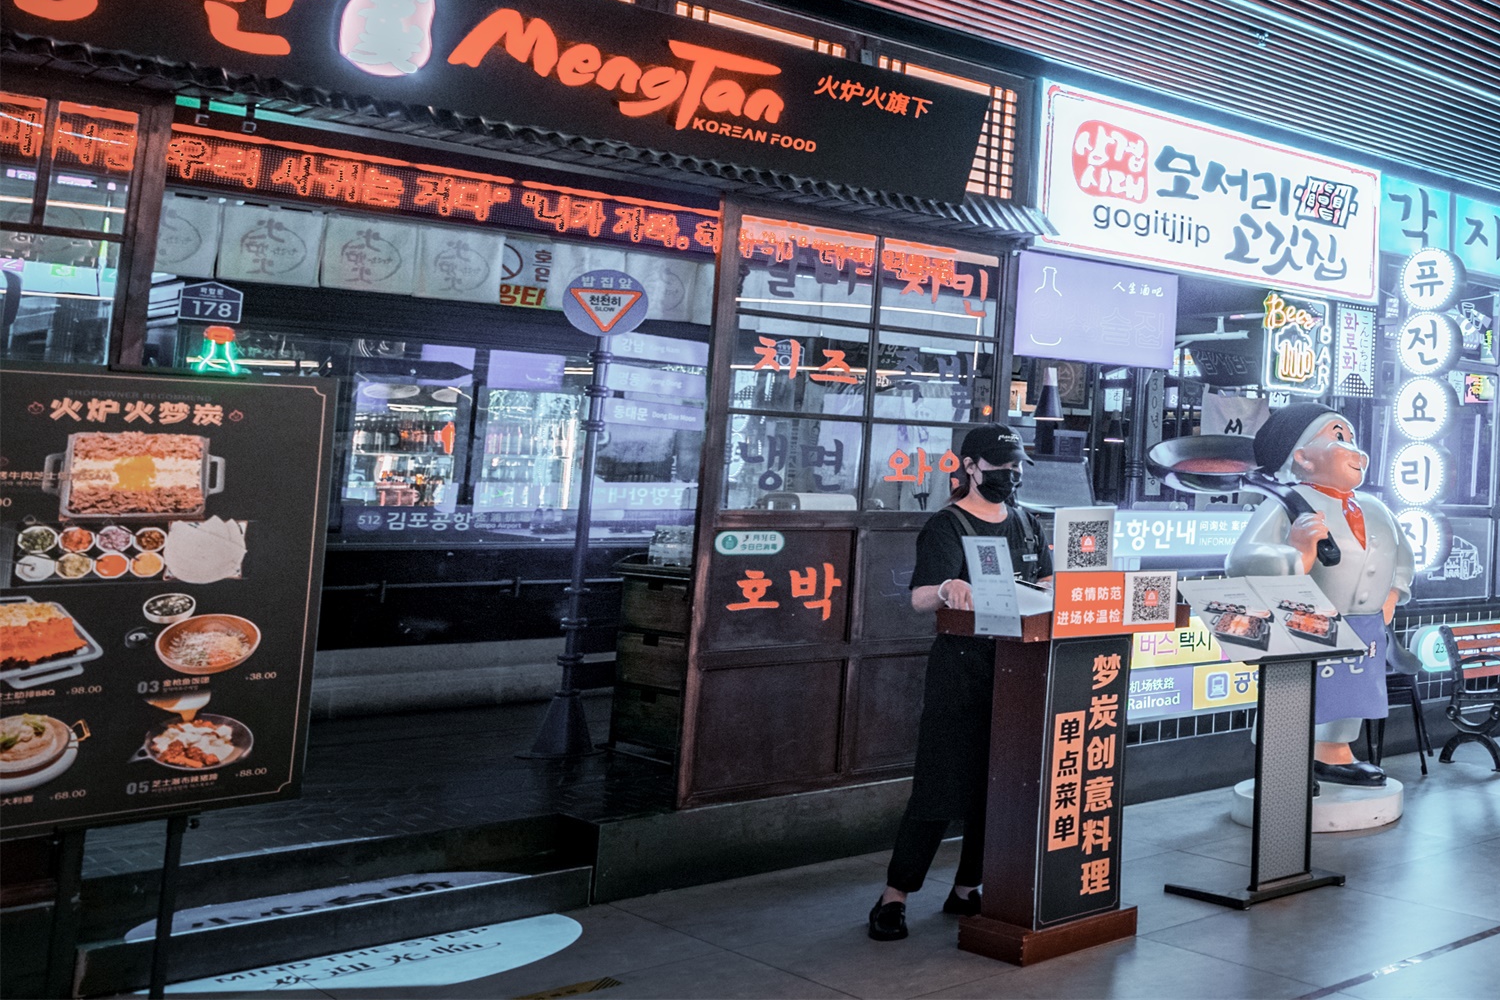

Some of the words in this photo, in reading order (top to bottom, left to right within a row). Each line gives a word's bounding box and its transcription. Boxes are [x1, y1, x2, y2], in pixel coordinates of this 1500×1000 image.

[447, 7, 785, 130] MengTan
[814, 74, 933, 120] 火炉火旗下
[692, 116, 767, 144] KOREAN
[769, 132, 818, 154] FOOD
[1154, 145, 1291, 217] 모서리
[1093, 204, 1211, 248] gogitjjip
[1224, 213, 1348, 282] 고깃집
[589, 294, 622, 307] 천천히
[1113, 281, 1164, 297] 人生酒吧
[192, 300, 232, 318] 178
[1263, 293, 1316, 330] Beer
[1316, 325, 1332, 387] BAR
[1358, 314, 1370, 373] こんにちは
[752, 335, 859, 385] 치즈
[50, 397, 224, 426] 火炉火梦炭
[613, 404, 648, 422] 동대문
[358, 514, 381, 526] 512
[387, 511, 473, 532] 김포공항
[1200, 520, 1228, 532] 问询处
[1200, 536, 1239, 546] INFORMA
[726, 562, 842, 621] 호박
[1071, 586, 1122, 602] 疫情防范
[1057, 609, 1125, 626] 进场体温检
[1179, 630, 1212, 653] 택시
[137, 680, 160, 694] 03
[1129, 676, 1175, 694] 机场铁路
[1128, 691, 1180, 711] Railroad
[126, 781, 149, 795] 05
[1053, 719, 1081, 843] 单点菜单
[1079, 654, 1122, 897] 梦炭创意料理
[214, 962, 311, 984] MIND
[325, 946, 391, 963] THE
[410, 926, 490, 948] STEP
